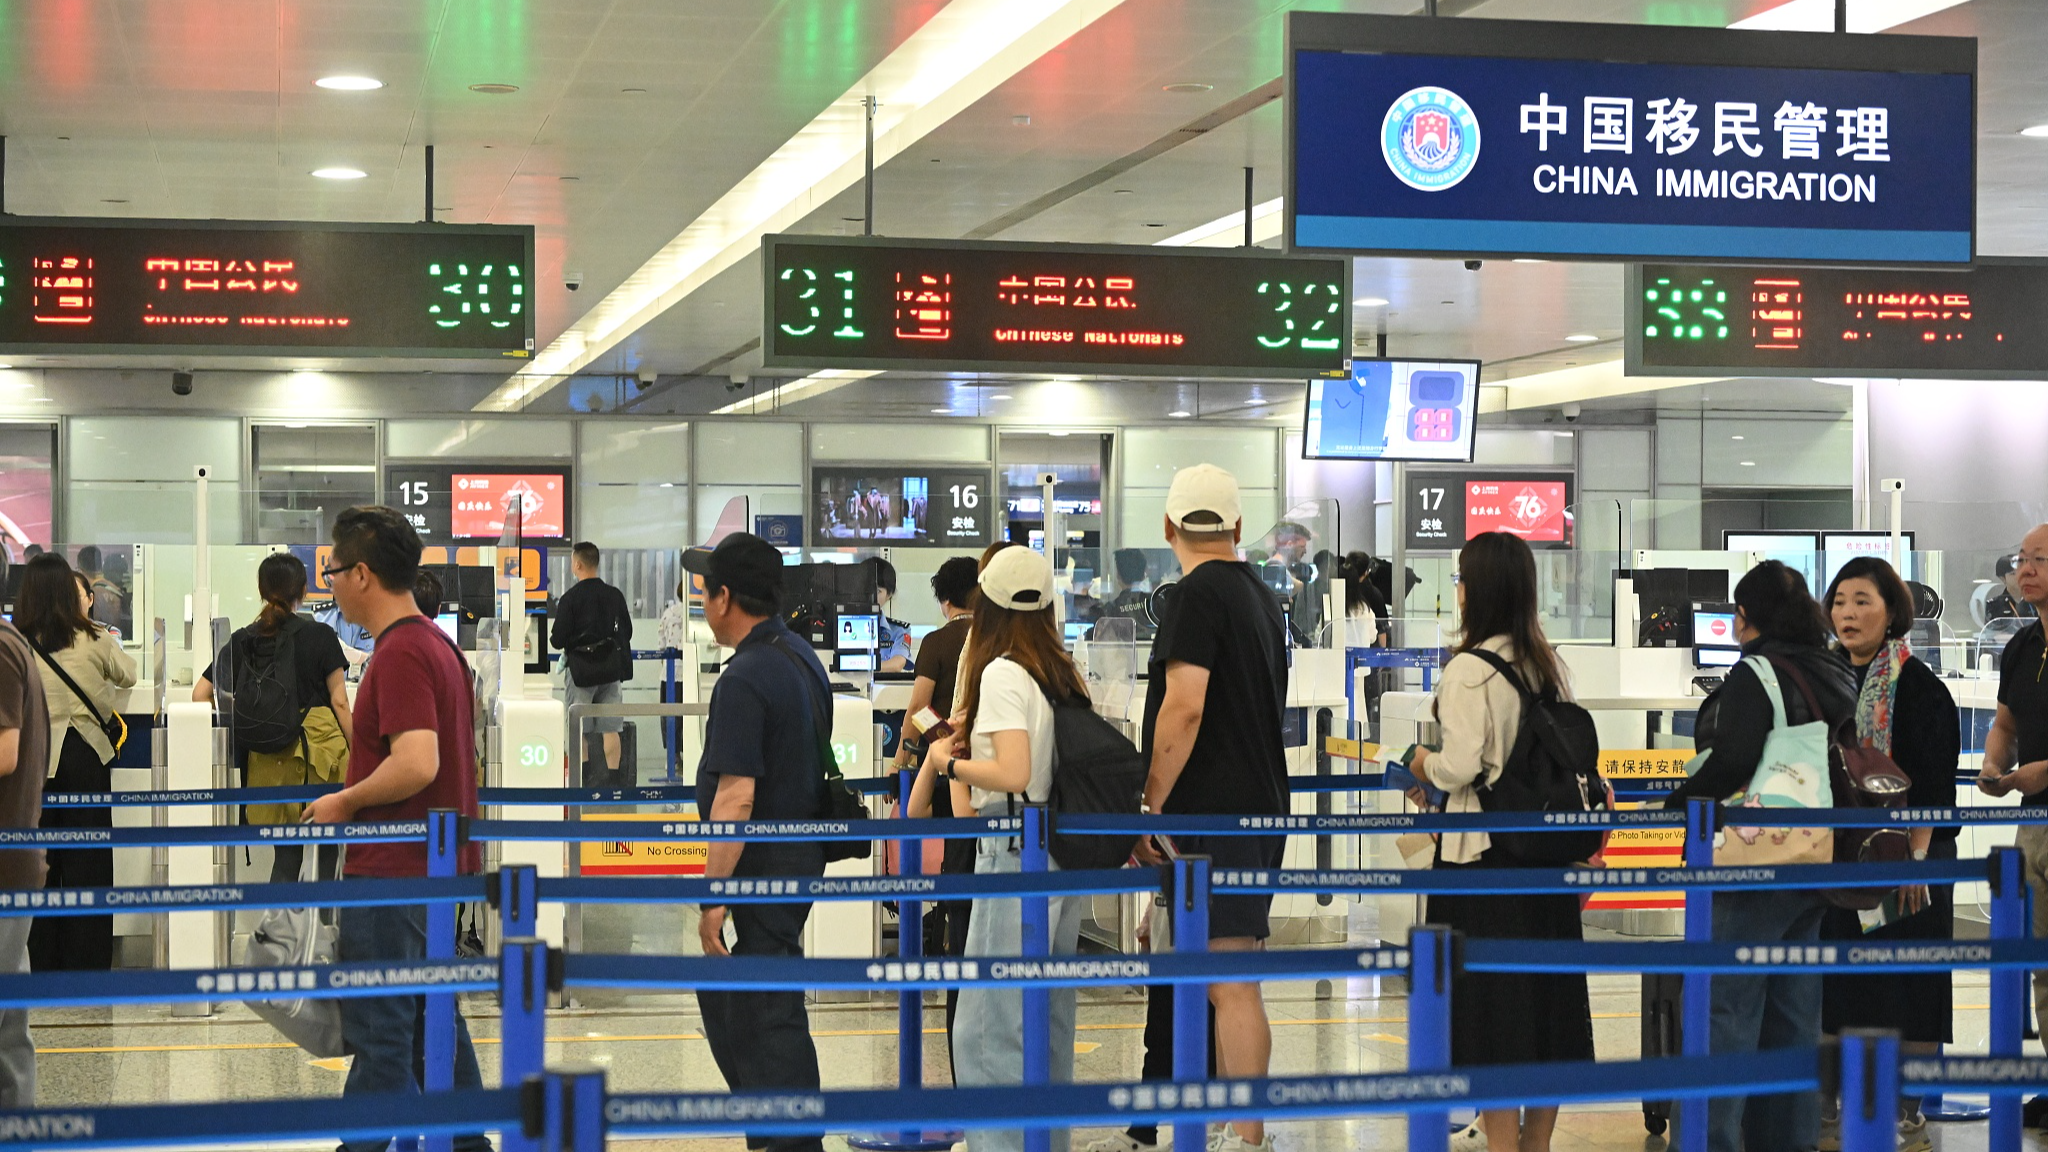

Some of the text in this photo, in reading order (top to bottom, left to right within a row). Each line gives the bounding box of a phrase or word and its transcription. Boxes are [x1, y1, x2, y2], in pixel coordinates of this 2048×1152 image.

[1520, 92, 1891, 162] 中国移民管理
[1390, 147, 1472, 184] CHINA IMMIGRATION
[1533, 164, 1876, 203] CHINA IMMIGRATION
[780, 268, 864, 338] 31
[1256, 281, 1340, 350] 32
[399, 481, 430, 506] 15
[949, 484, 979, 509] 16
[1418, 487, 1445, 511] 17
[1514, 495, 1542, 519] 76
[952, 516, 975, 529] 安检
[1420, 518, 1443, 531] 安检
[1120, 602, 1146, 613] SECURI
[520, 744, 548, 766] 30
[833, 743, 857, 764] 31
[1605, 759, 1686, 775] 请保持安静
[47, 791, 214, 804] 中国移民管理 CHINA IMMIGRATION
[1239, 816, 1414, 828] 中国移民管理 CHINA IMMIGRATION
[1618, 812, 1649, 823] CHINA
[1650, 811, 1686, 822] IMMIGR
[1890, 808, 2048, 821] 中国移民管理 CHINA IMMIGRATION
[260, 823, 427, 838] 中国移民管理 CHINA IMMIGRA
[663, 823, 848, 836] 中国移民管理 CHINA IMMIGRATION
[987, 818, 1022, 830] 中国移
[0, 831, 111, 842] CHINA IMMIGRATION
[1618, 831, 1639, 839] Photo
[1641, 831, 1664, 841] Taking
[1674, 831, 1686, 839] Vid
[648, 846, 707, 857] No Crossing
[1212, 871, 1401, 885] 移民管理 CHINA IMMIGRATION
[1656, 872, 1695, 884] CHINA
[1695, 869, 1775, 882] IMMIGRATION
[808, 880, 849, 894] CHINA
[850, 878, 935, 893] IMMIGRATION
[106, 891, 150, 905] CHINA
[151, 888, 243, 903] IMMIGRATION
